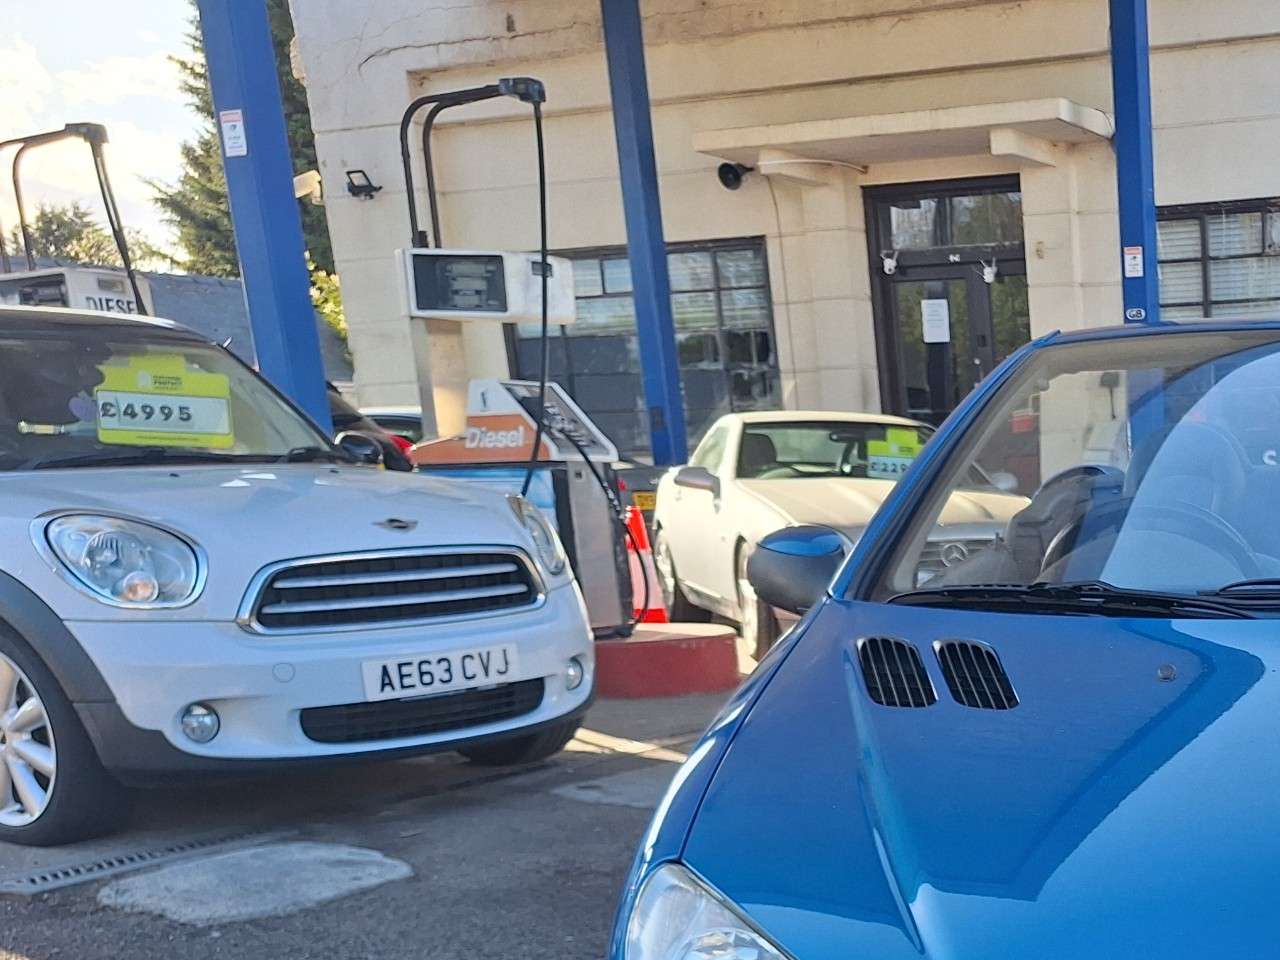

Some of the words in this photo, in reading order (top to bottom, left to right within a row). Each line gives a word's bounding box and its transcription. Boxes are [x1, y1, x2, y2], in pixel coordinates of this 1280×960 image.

[85, 296, 135, 314] DIESE
[1128, 309, 1143, 319] GB
[100, 402, 193, 422] £4995
[465, 425, 525, 449] Diesel
[380, 657, 453, 693] AE63
[461, 649, 510, 681] CVJ
